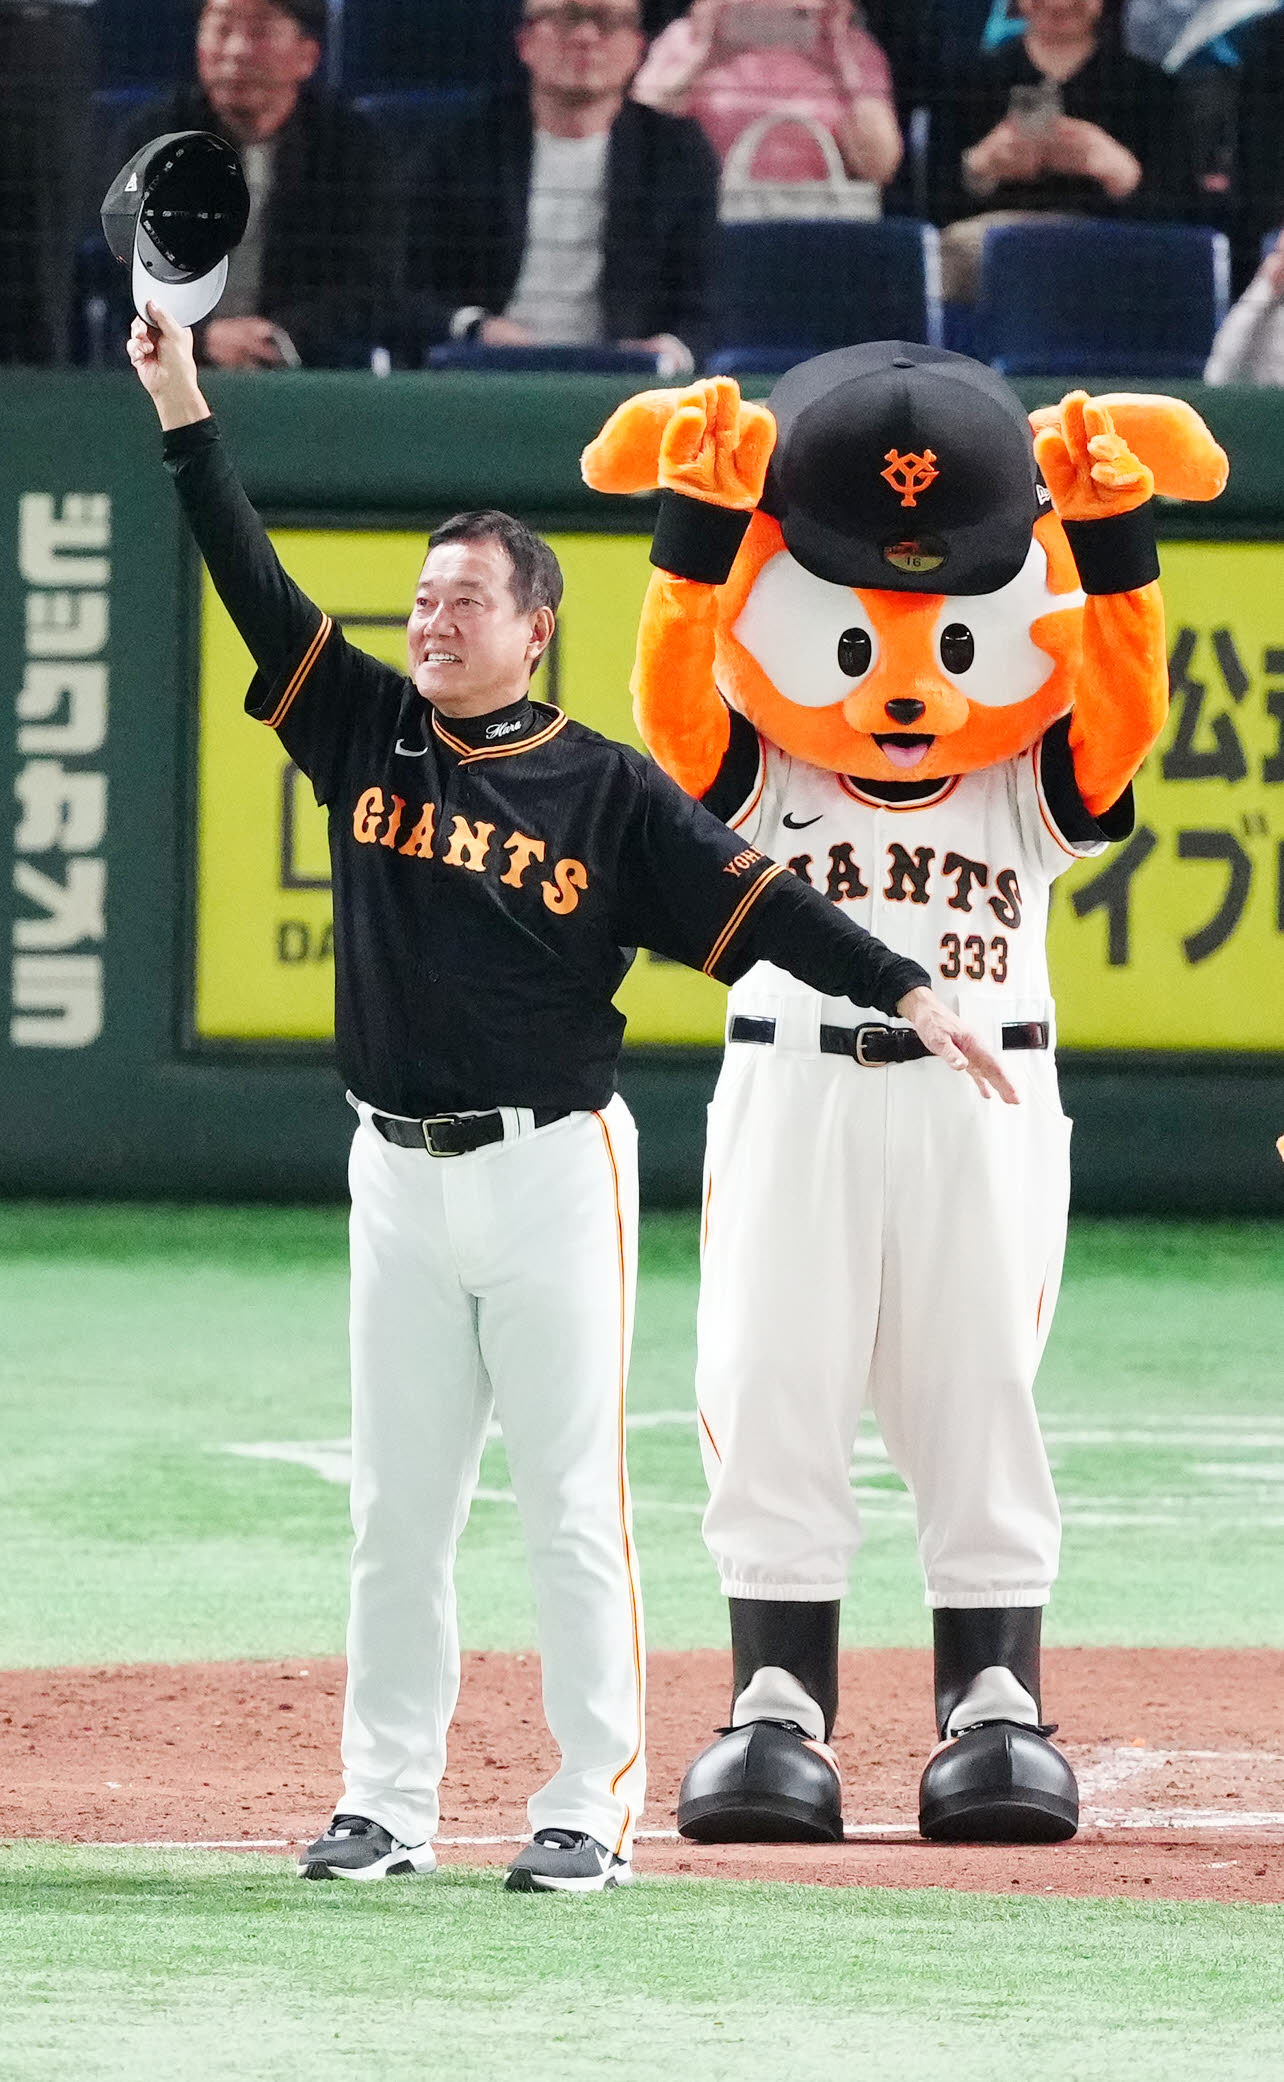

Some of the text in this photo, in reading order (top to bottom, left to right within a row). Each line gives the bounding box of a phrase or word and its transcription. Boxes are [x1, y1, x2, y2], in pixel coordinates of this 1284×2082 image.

[486, 721, 521, 739] Hara
[352, 786, 590, 916] GIANTS
[786, 841, 1023, 930] IANTS
[1072, 813, 1284, 967] イブ
[940, 933, 1008, 984] 333
